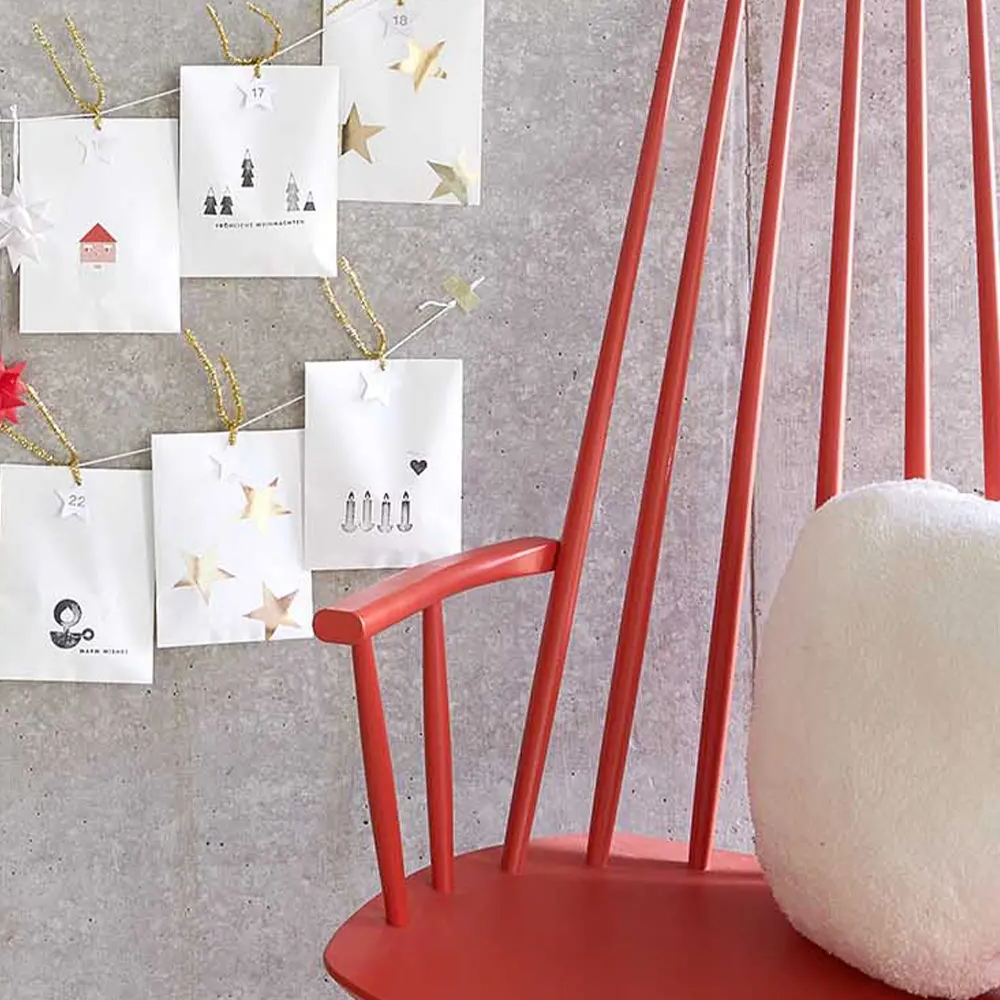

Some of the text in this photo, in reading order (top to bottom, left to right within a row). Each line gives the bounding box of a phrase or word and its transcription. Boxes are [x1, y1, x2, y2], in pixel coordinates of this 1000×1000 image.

[393, 15, 409, 26] 18
[251, 87, 265, 98] 17
[67, 495, 87, 508] 22
